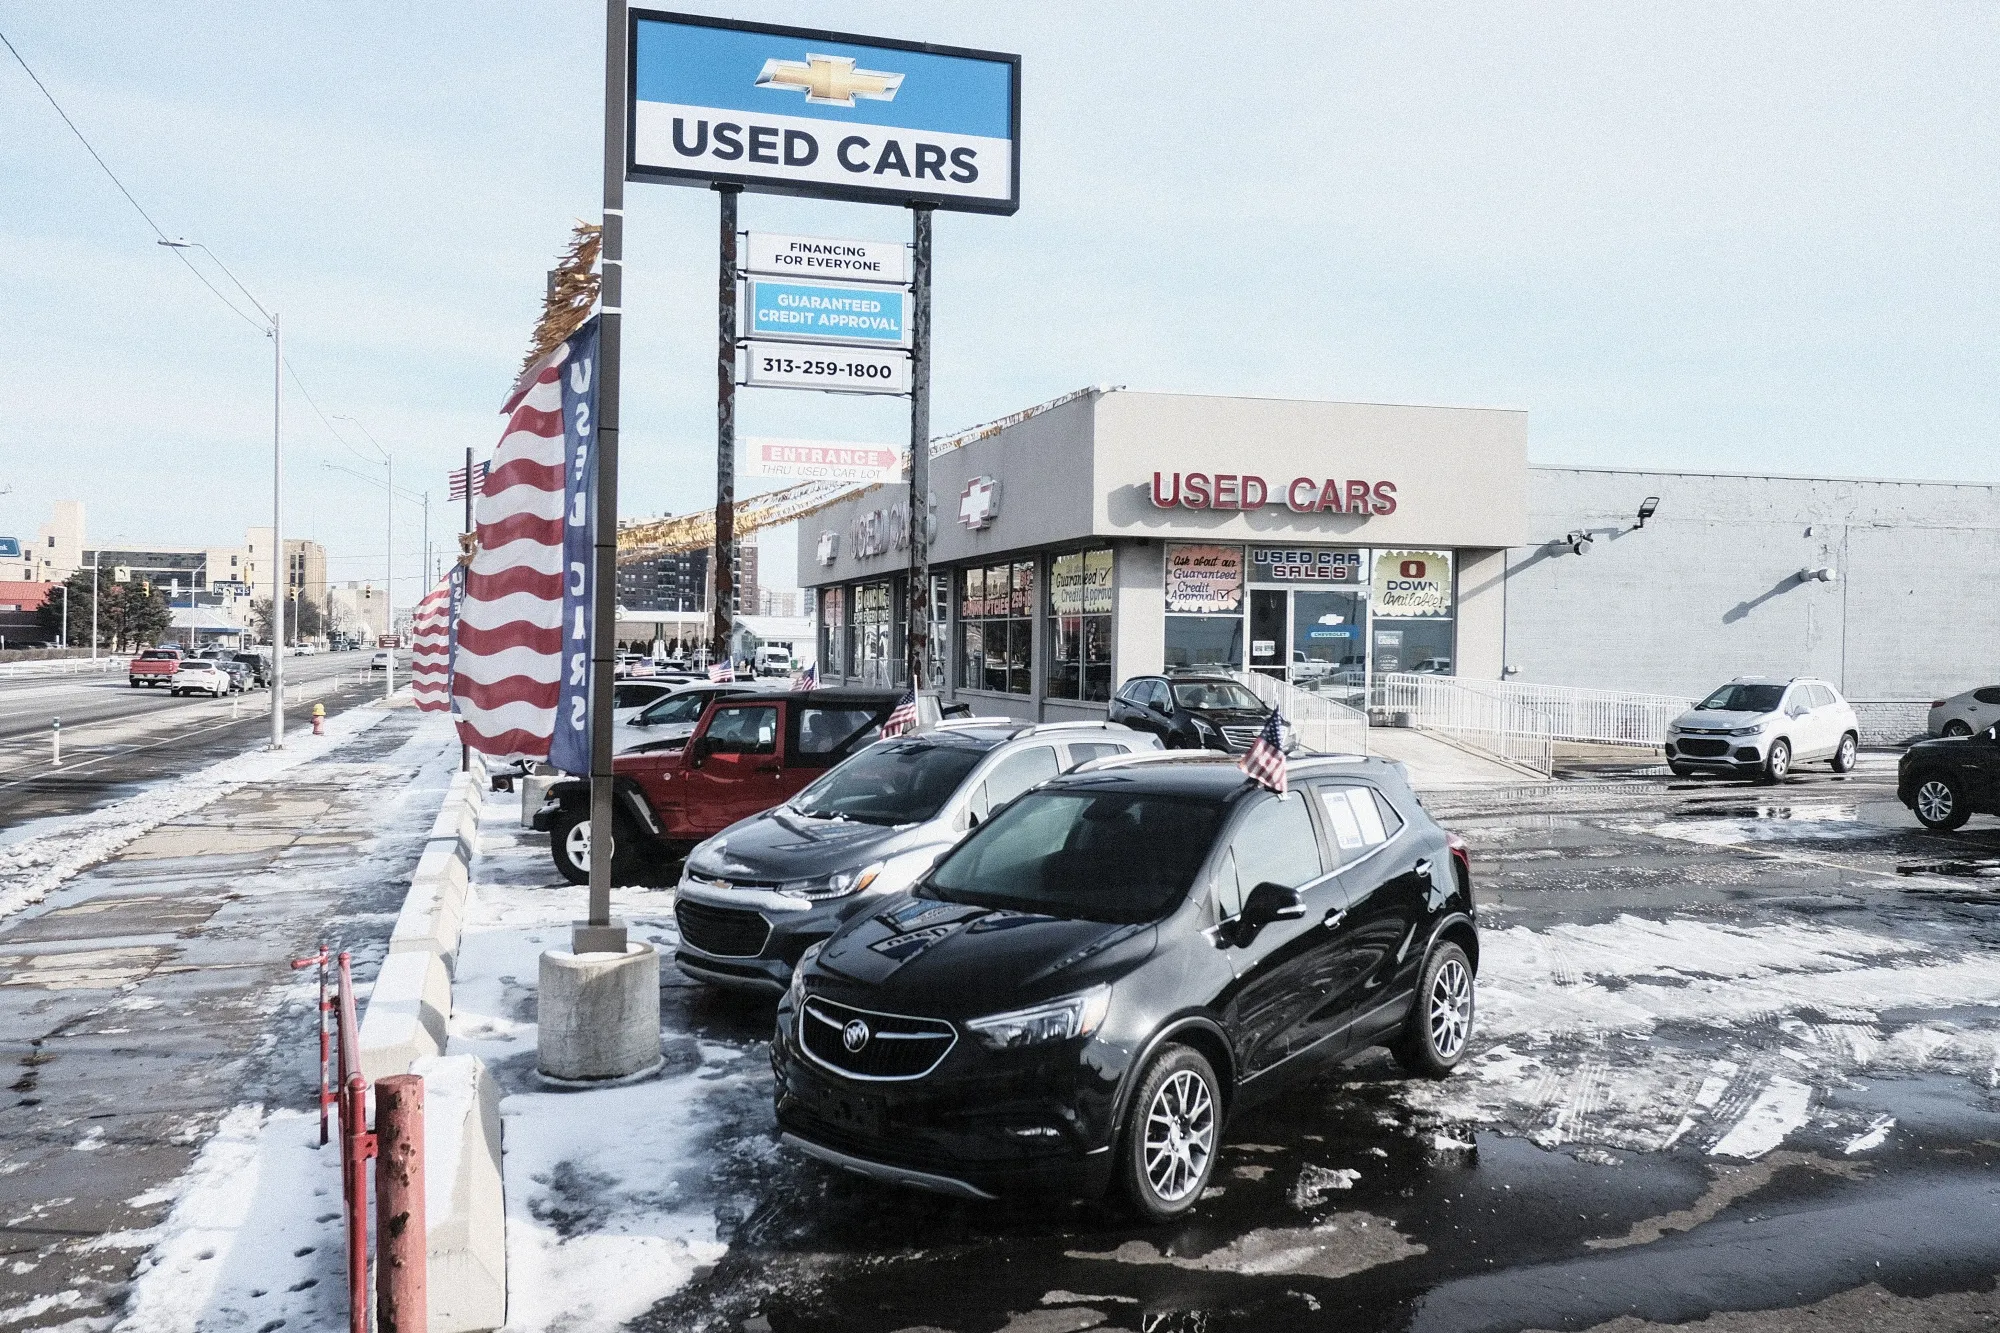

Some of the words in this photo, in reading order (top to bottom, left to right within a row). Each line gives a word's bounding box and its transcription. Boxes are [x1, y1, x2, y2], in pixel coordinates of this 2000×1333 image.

[672, 117, 819, 167] USED
[836, 135, 979, 184] CARS
[790, 242, 866, 257] FINANCING
[775, 254, 803, 266] FOR
[807, 257, 881, 272] EVERYONE
[777, 293, 881, 313] GUARANTEED
[758, 308, 815, 325] CREDIT
[818, 313, 899, 331] APPROVAL
[763, 357, 892, 379] 313-259-1800
[770, 446, 879, 466] ENTRANCE
[762, 464, 792, 475] THRU
[797, 466, 828, 477] USED
[833, 468, 857, 478] CAR
[861, 470, 882, 479] LOT
[1152, 471, 1268, 510] USED
[1288, 477, 1398, 516] CARS
[1253, 550, 1313, 564] USED
[1317, 552, 1361, 565] CAR
[1056, 568, 1098, 588] Guaraneed
[1173, 568, 1237, 579] Guaranteed
[1273, 565, 1347, 579] SALES
[1178, 580, 1210, 593] Credit
[1387, 580, 1439, 592] DOWN
[1171, 590, 1216, 604] Approval
